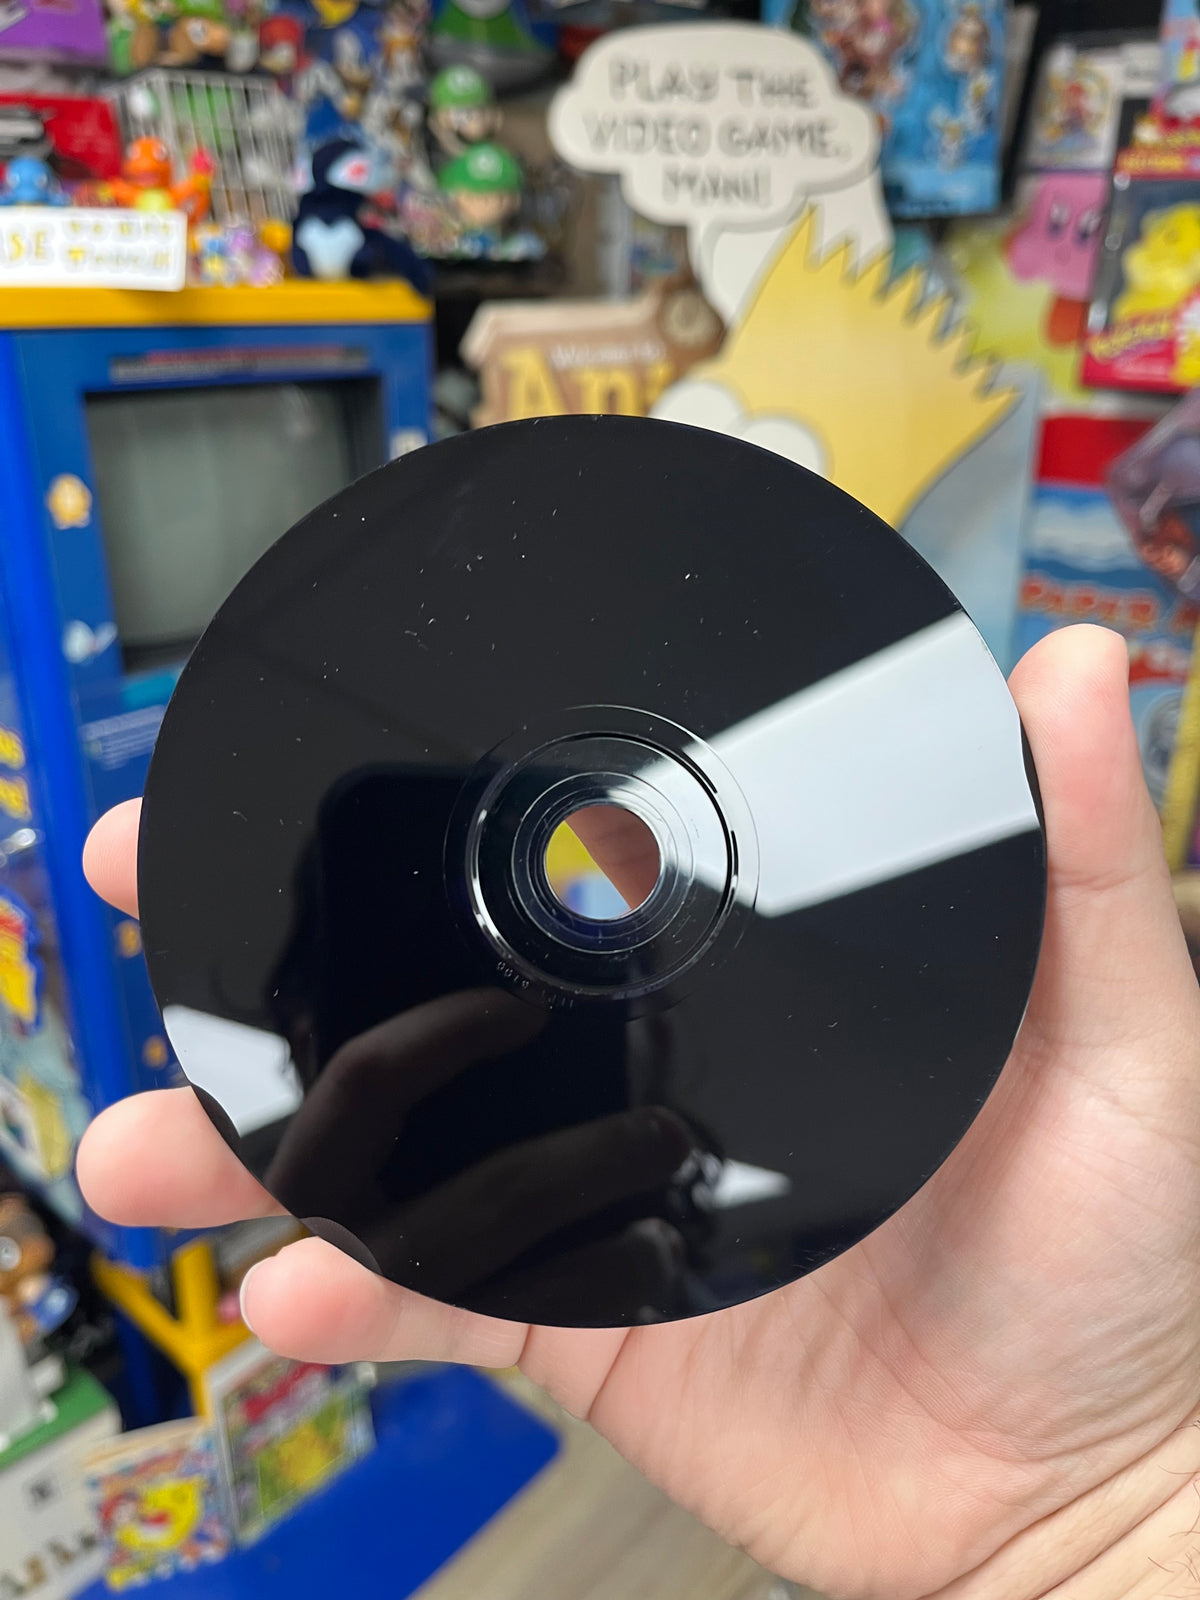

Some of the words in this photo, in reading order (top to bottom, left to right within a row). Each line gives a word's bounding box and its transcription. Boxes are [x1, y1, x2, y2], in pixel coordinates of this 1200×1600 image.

[609, 57, 718, 101] PLAY
[727, 68, 818, 108] THE
[583, 112, 712, 158] VIDEO
